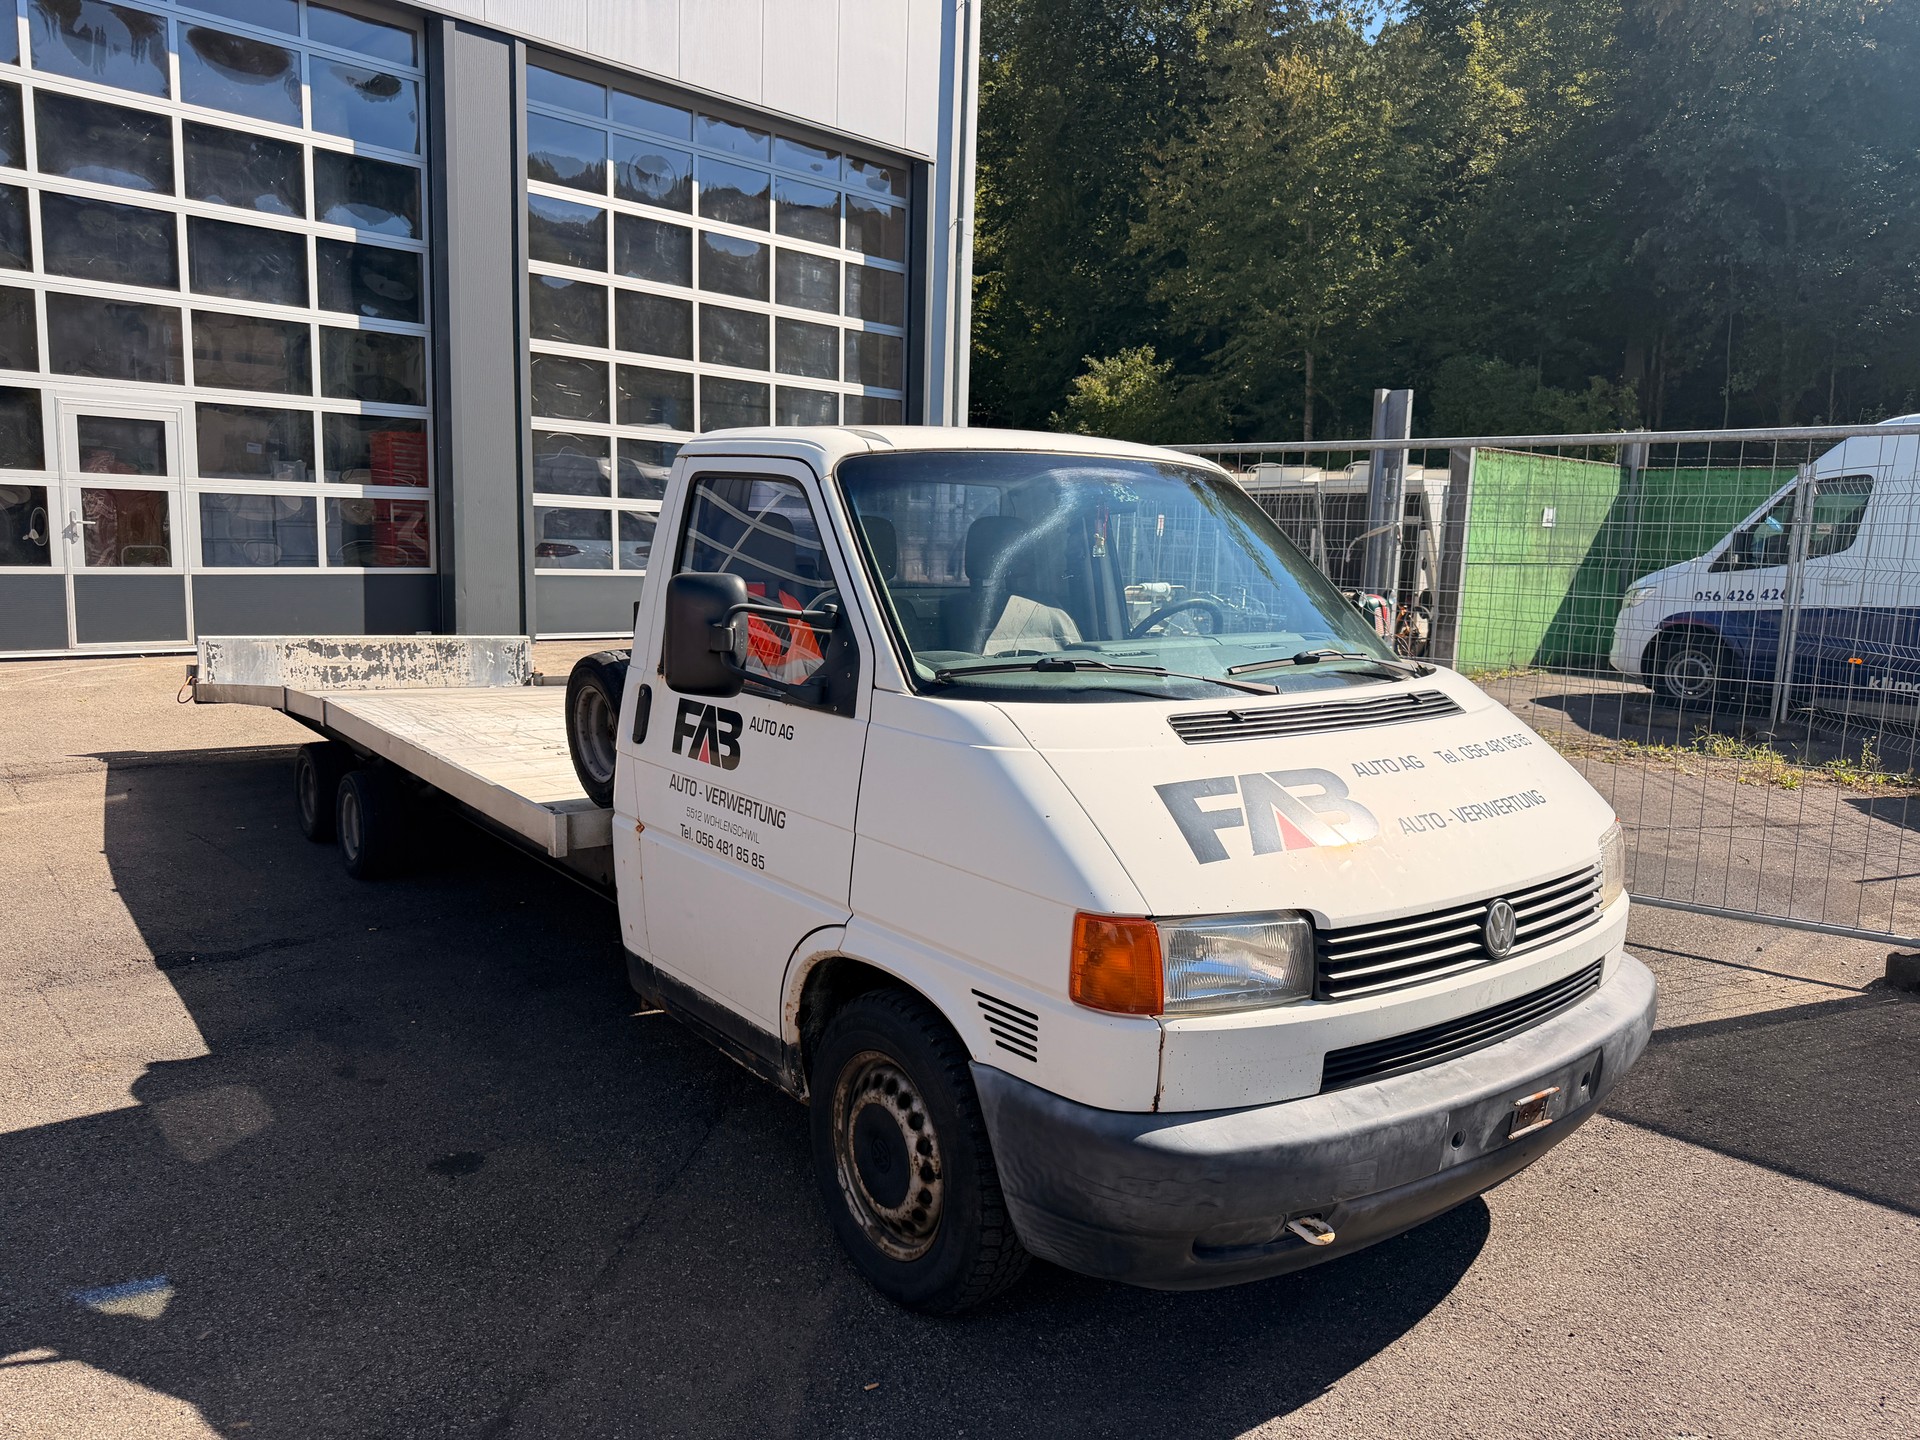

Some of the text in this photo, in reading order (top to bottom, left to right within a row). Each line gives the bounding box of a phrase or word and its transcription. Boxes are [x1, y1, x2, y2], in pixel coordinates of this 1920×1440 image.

[1695, 591, 1721, 602] 056
[1727, 590, 1755, 601] 426
[672, 697, 743, 771] FAB
[749, 716, 794, 741] AUTO AG
[1351, 733, 1532, 777] AUTO AG Tel. 056 481 85 85
[669, 773, 697, 797] AUTO
[705, 784, 786, 829] VERWERTUNG
[1153, 767, 1379, 865] FAB
[1398, 812, 1447, 836] AUTO
[1449, 789, 1547, 824] VERWERTUNG
[680, 823, 765, 870] Tel. 056 481 85 85
[686, 806, 760, 844] 5512 WOHLENSCHWIL
